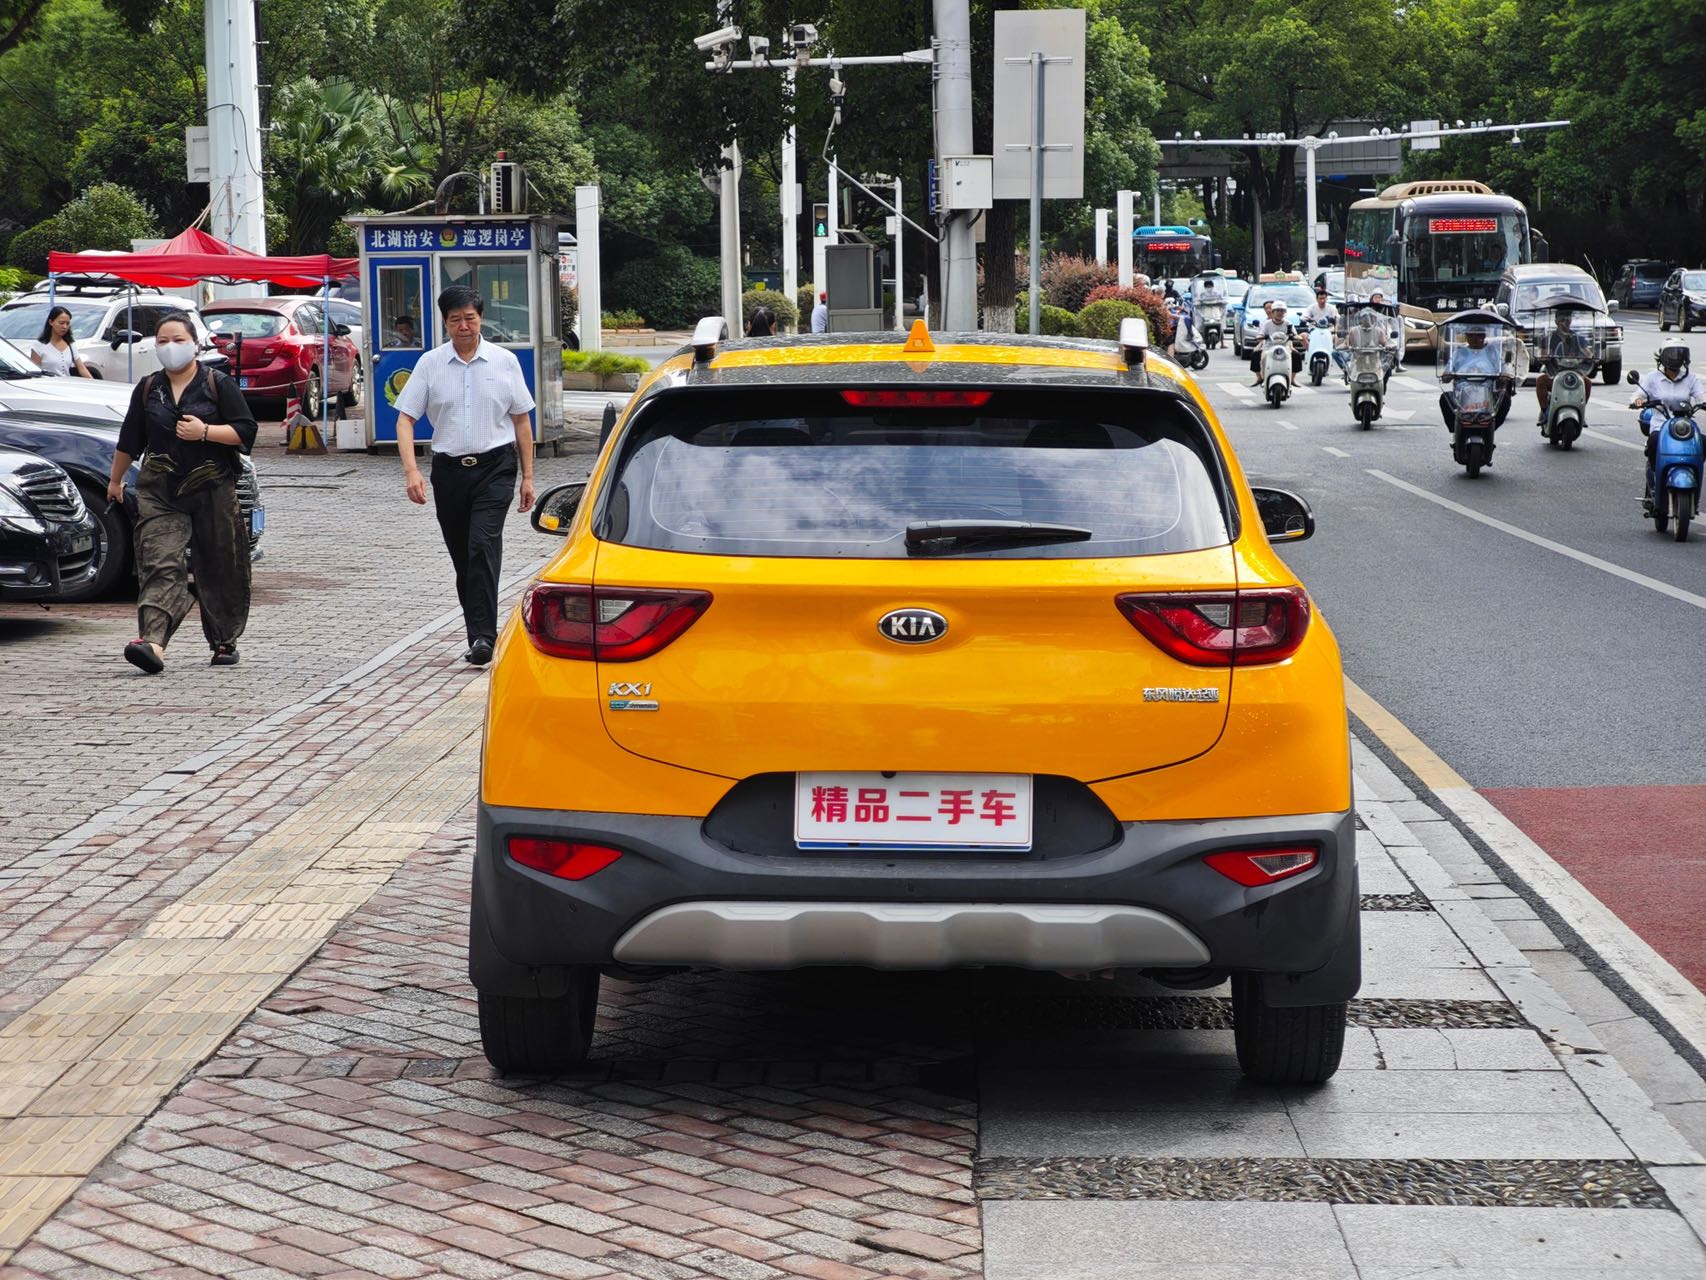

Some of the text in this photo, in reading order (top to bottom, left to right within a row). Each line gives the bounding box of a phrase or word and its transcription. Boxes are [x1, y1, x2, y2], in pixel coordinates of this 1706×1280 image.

[371, 227, 525, 248] 北湖治安 巡逻岗亭
[890, 616, 937, 636] KIA
[608, 682, 652, 696] KX1
[1142, 687, 1220, 702] 东风悦达起亚
[811, 785, 1017, 827] 精品二手车
